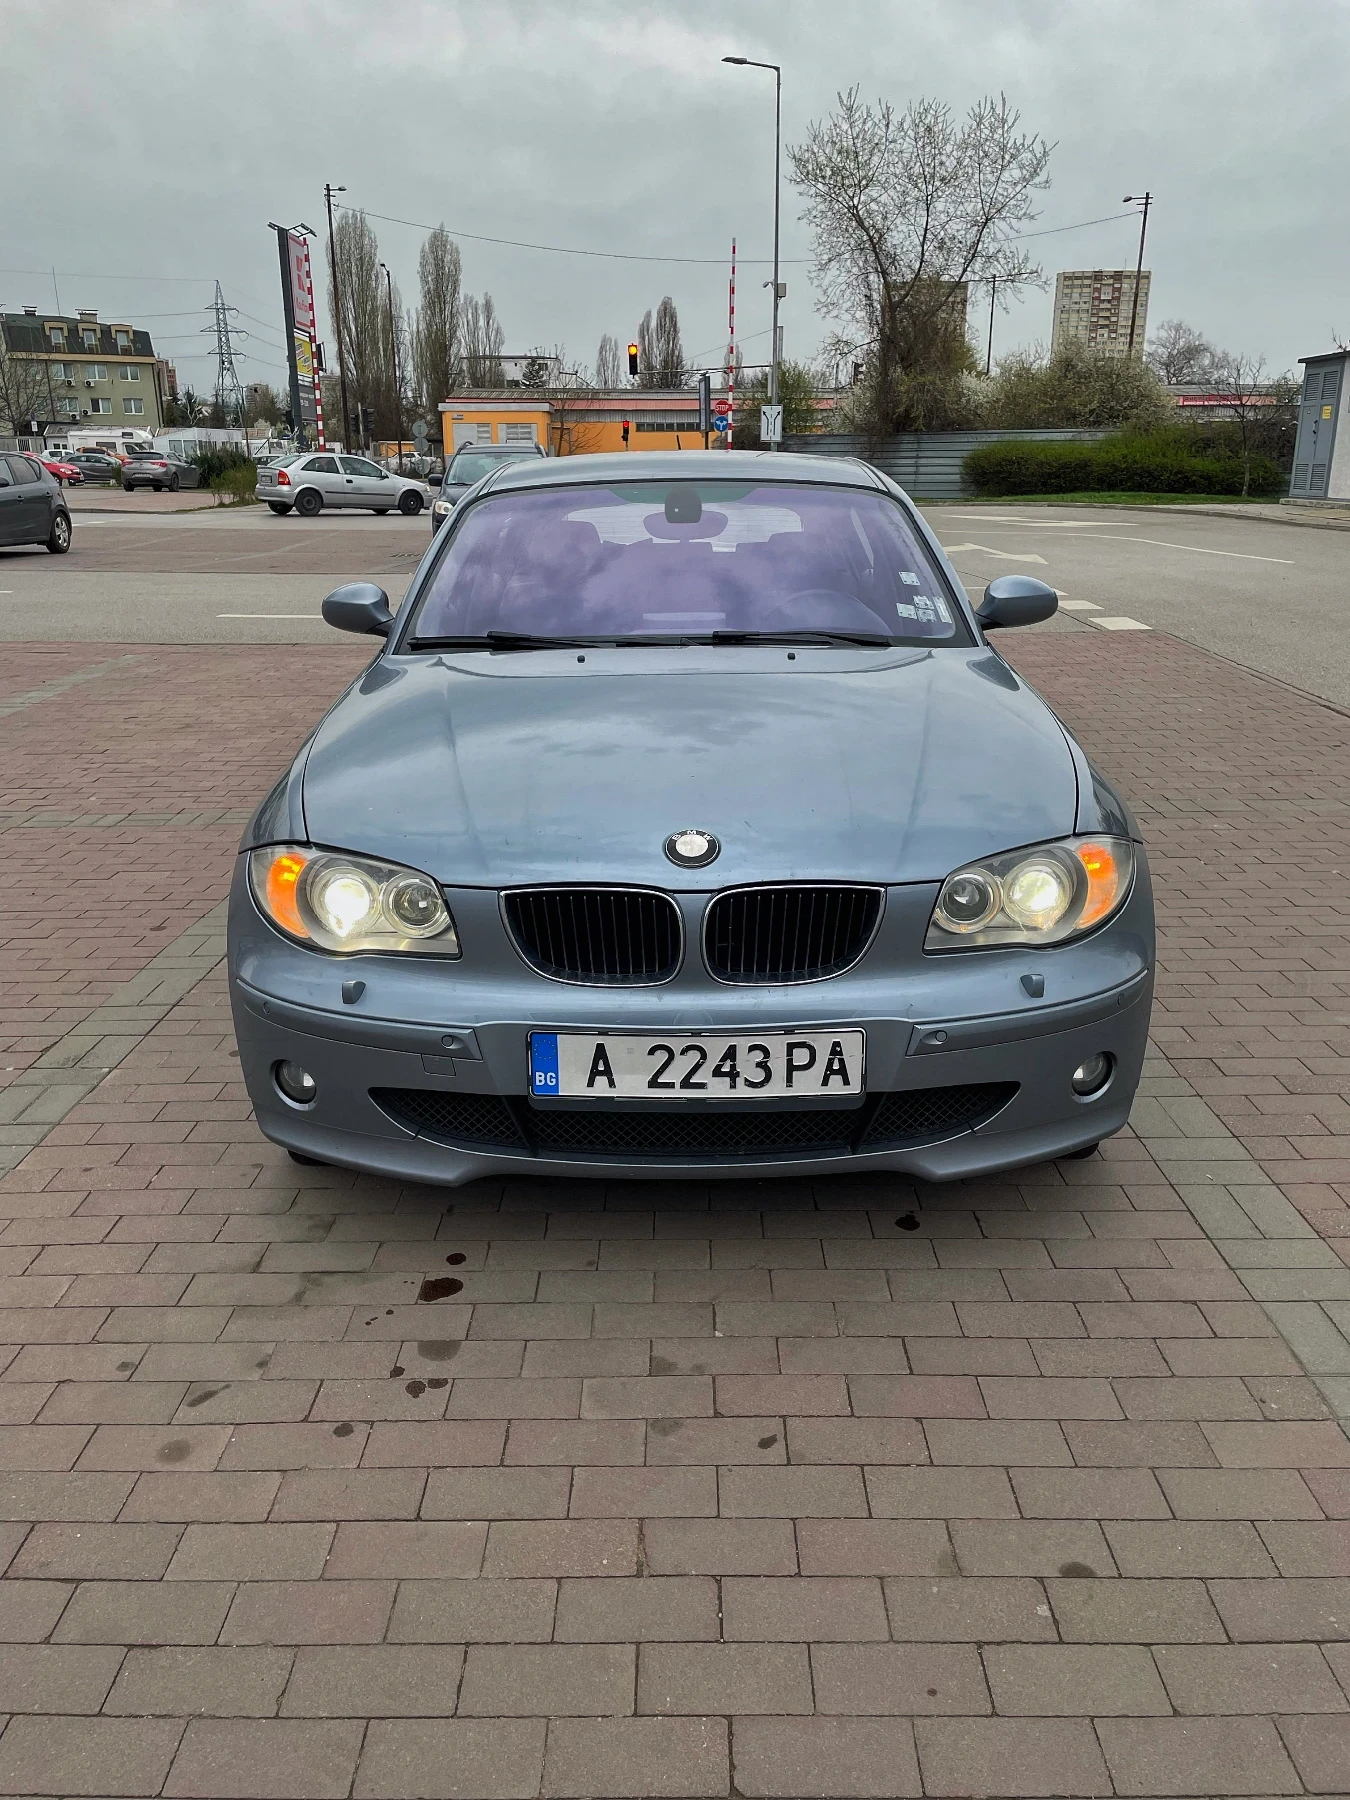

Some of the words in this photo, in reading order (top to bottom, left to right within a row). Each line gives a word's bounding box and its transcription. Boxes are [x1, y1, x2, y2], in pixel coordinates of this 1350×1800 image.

[672, 830, 713, 840] BMW
[586, 1042, 616, 1088] A
[535, 1072, 557, 1086] BG
